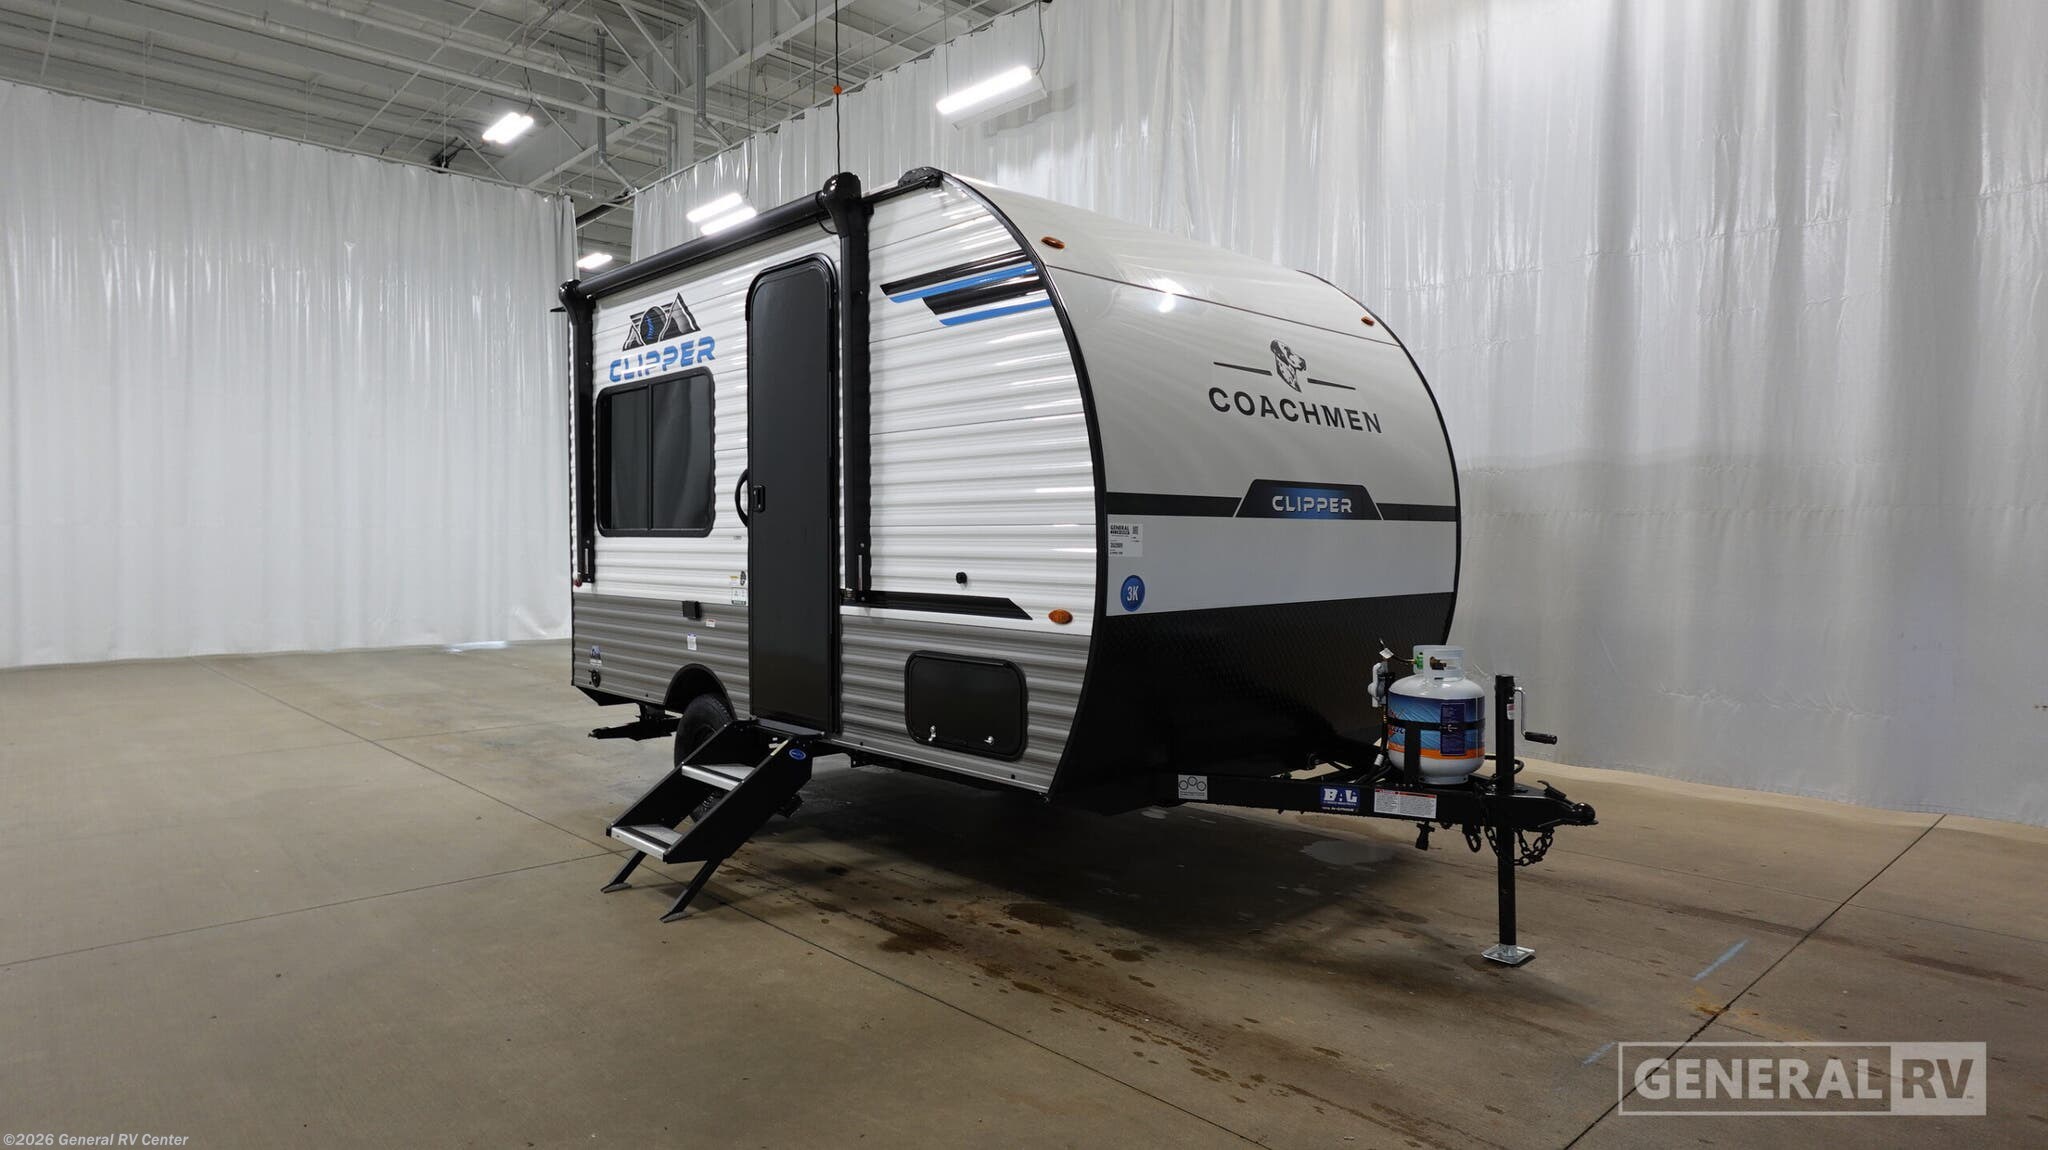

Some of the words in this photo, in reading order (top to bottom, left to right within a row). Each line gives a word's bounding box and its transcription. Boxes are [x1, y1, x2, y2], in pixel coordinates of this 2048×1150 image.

[609, 336, 715, 382] CLIPPER
[1208, 387, 1382, 433] COACHMEN
[1272, 495, 1352, 513] CLIPPER
[1127, 585, 1139, 601] 3K
